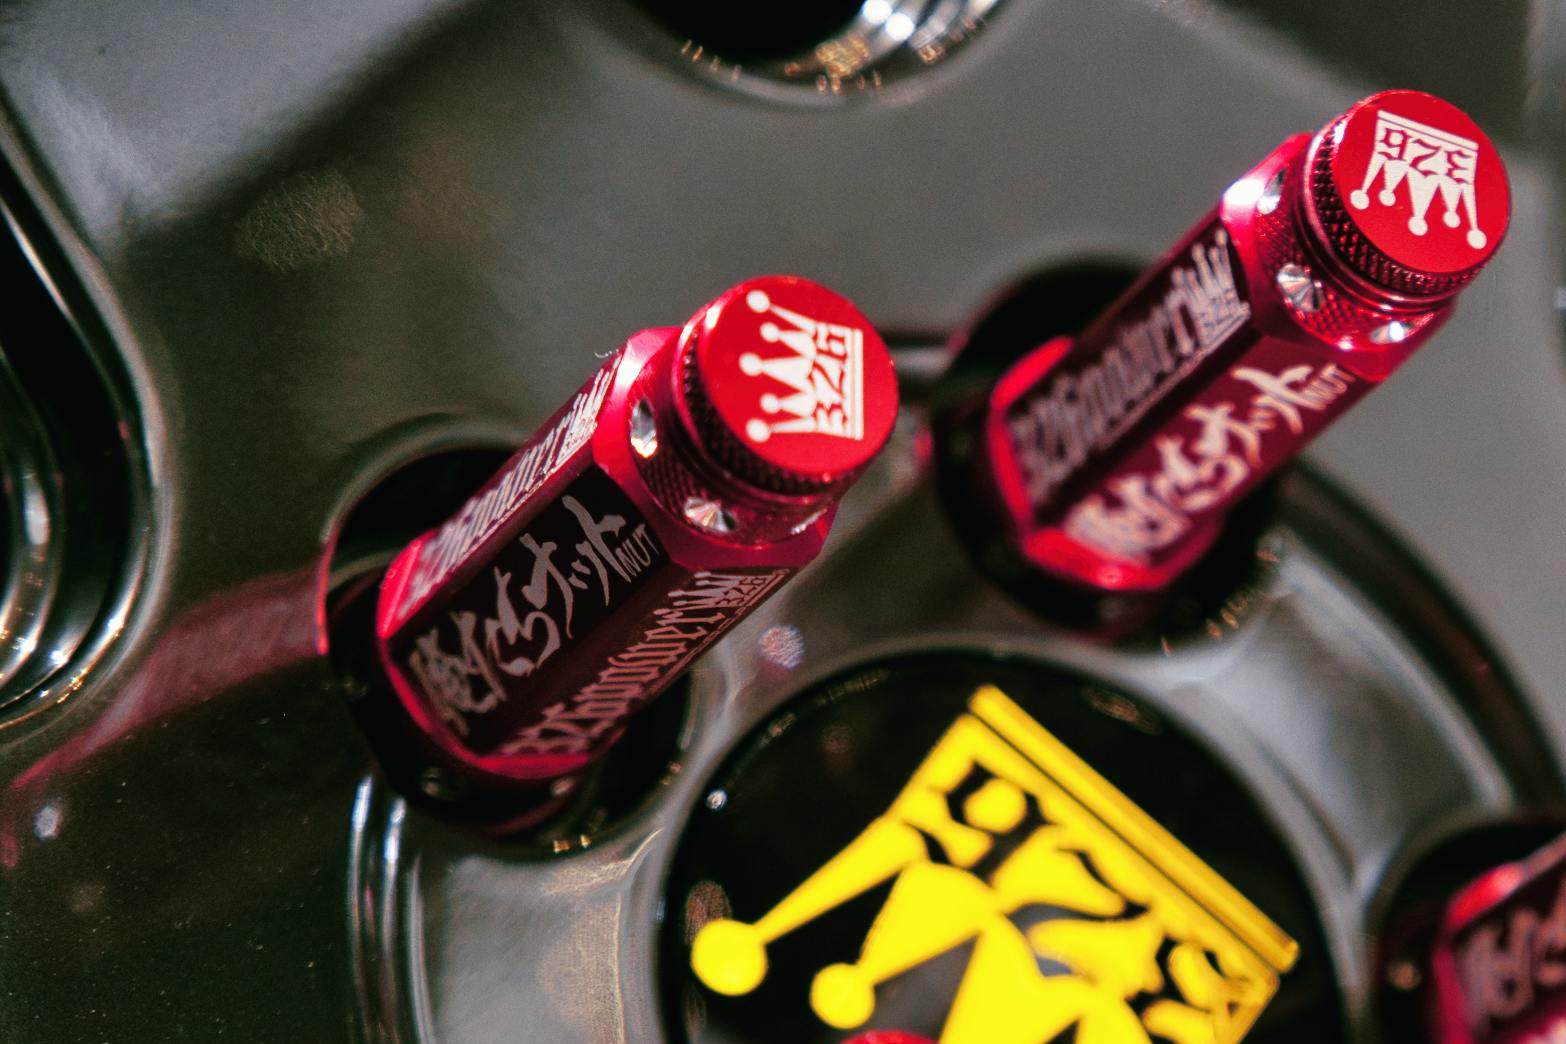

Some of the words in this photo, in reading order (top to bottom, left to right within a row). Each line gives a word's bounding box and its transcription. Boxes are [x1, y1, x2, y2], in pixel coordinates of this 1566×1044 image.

[1376, 127, 1474, 184] 326
[808, 323, 849, 433] 326
[615, 523, 662, 583] NUT
